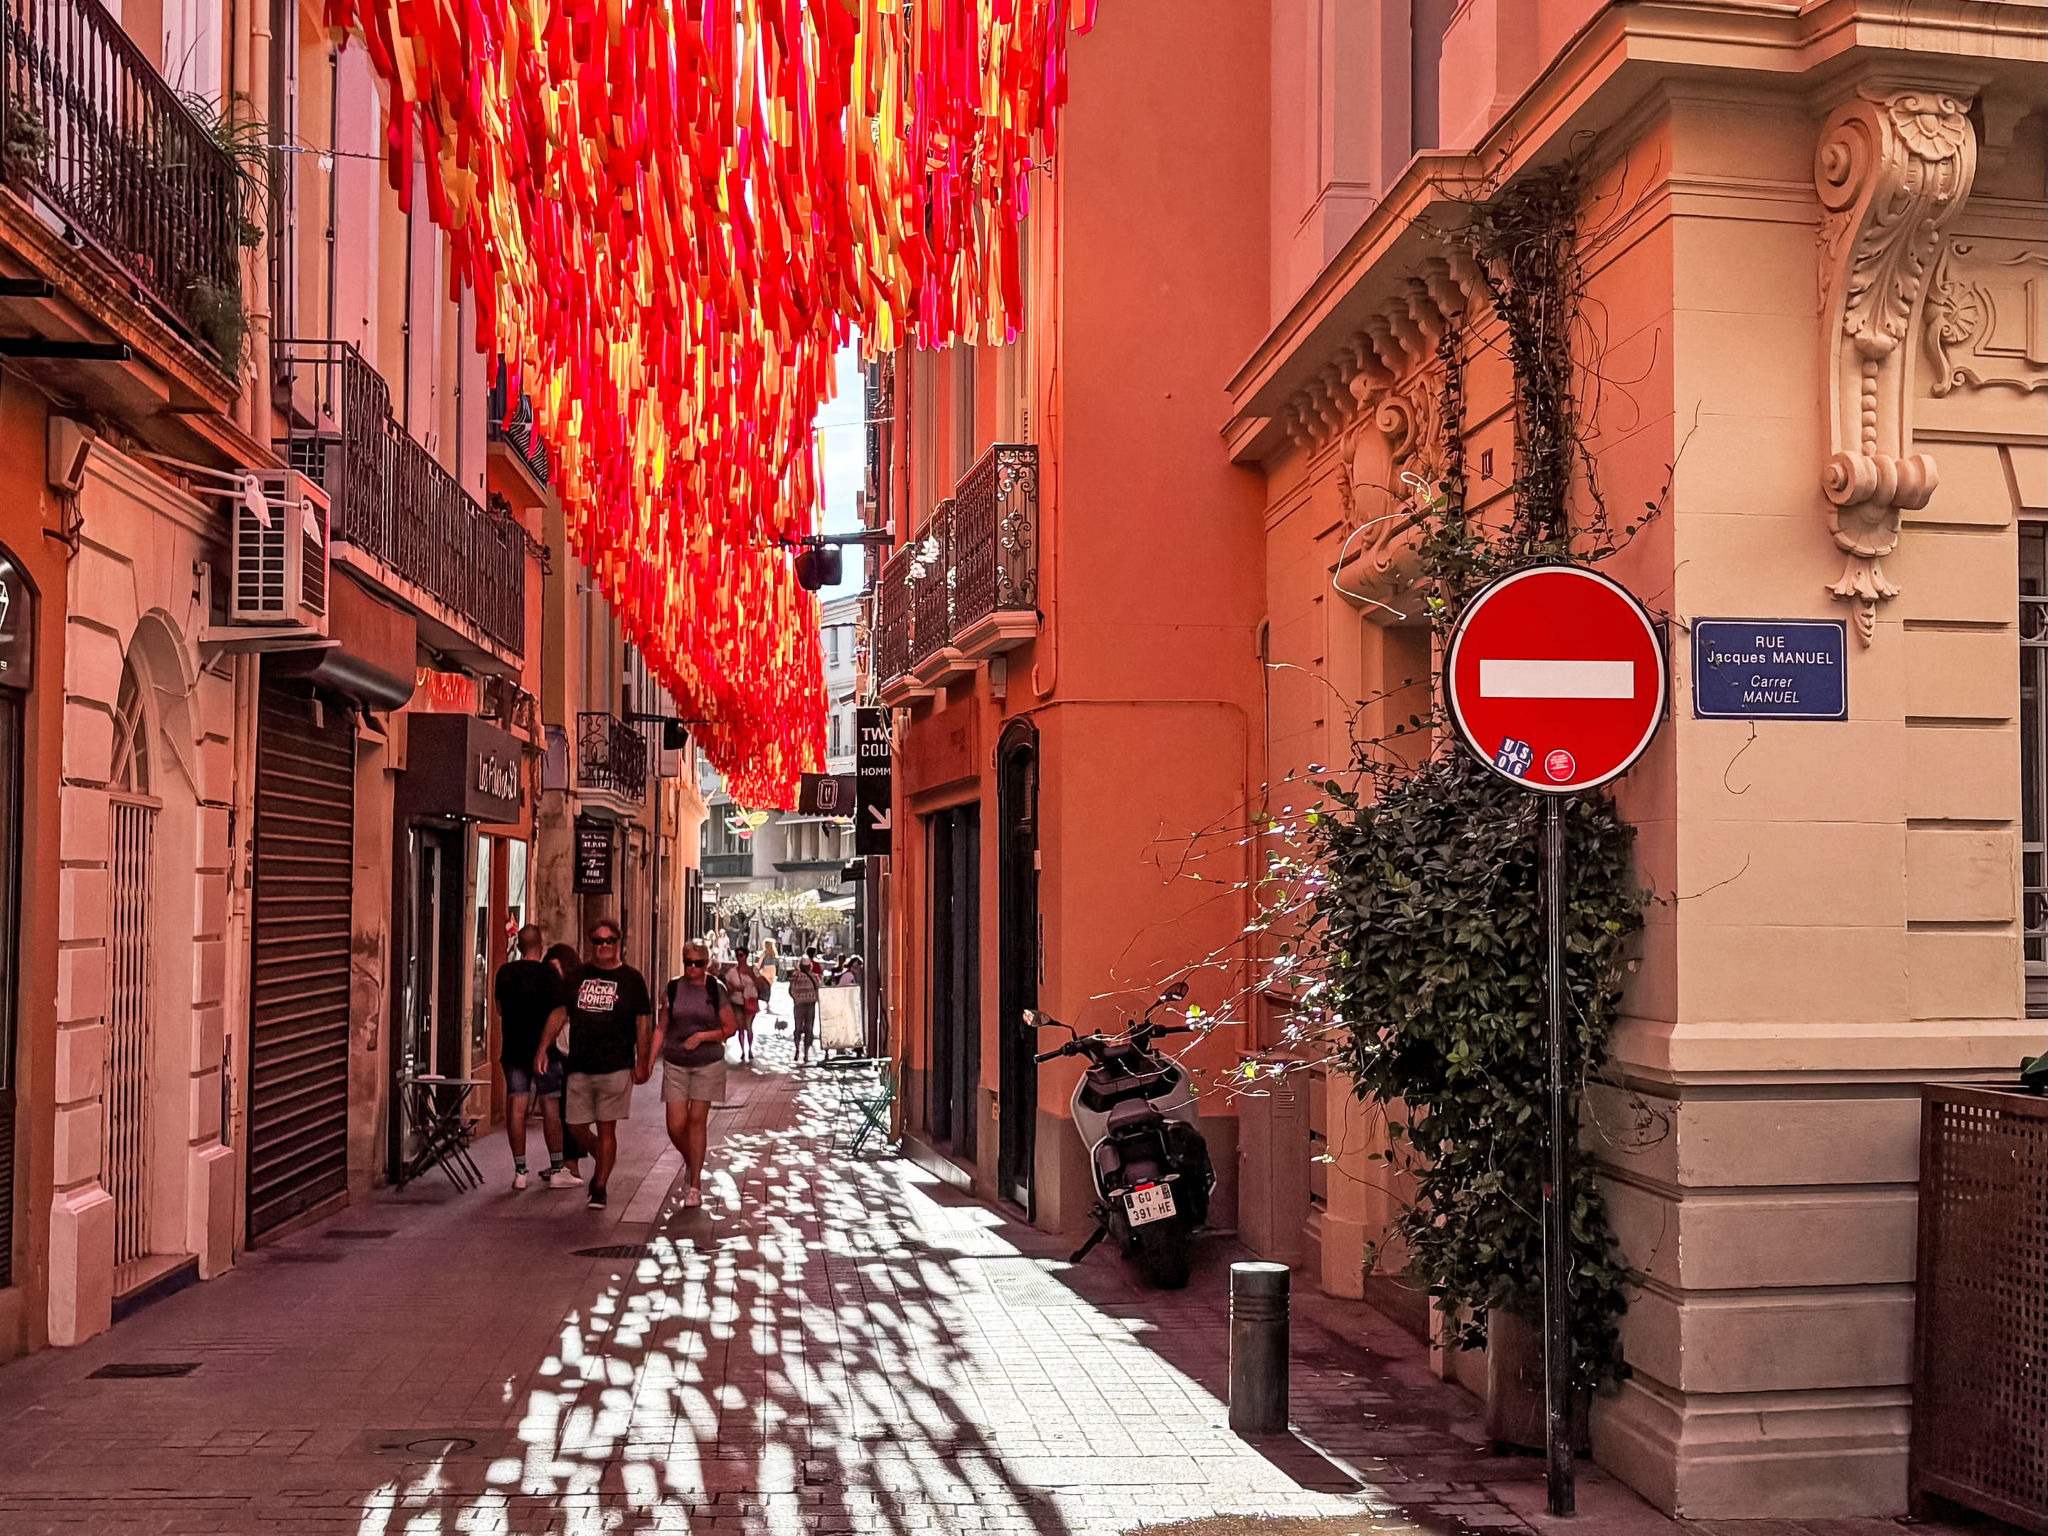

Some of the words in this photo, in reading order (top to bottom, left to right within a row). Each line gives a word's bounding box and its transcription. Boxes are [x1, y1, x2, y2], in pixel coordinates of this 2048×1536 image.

[1755, 635, 1785, 648] RUE
[1707, 650, 1766, 666] Jacques
[1772, 651, 1834, 665] MANUEL
[1750, 675, 1793, 688] Carrer
[1743, 690, 1800, 704] MANUEL
[861, 743, 893, 757] COU
[580, 993, 614, 1006] JONES
